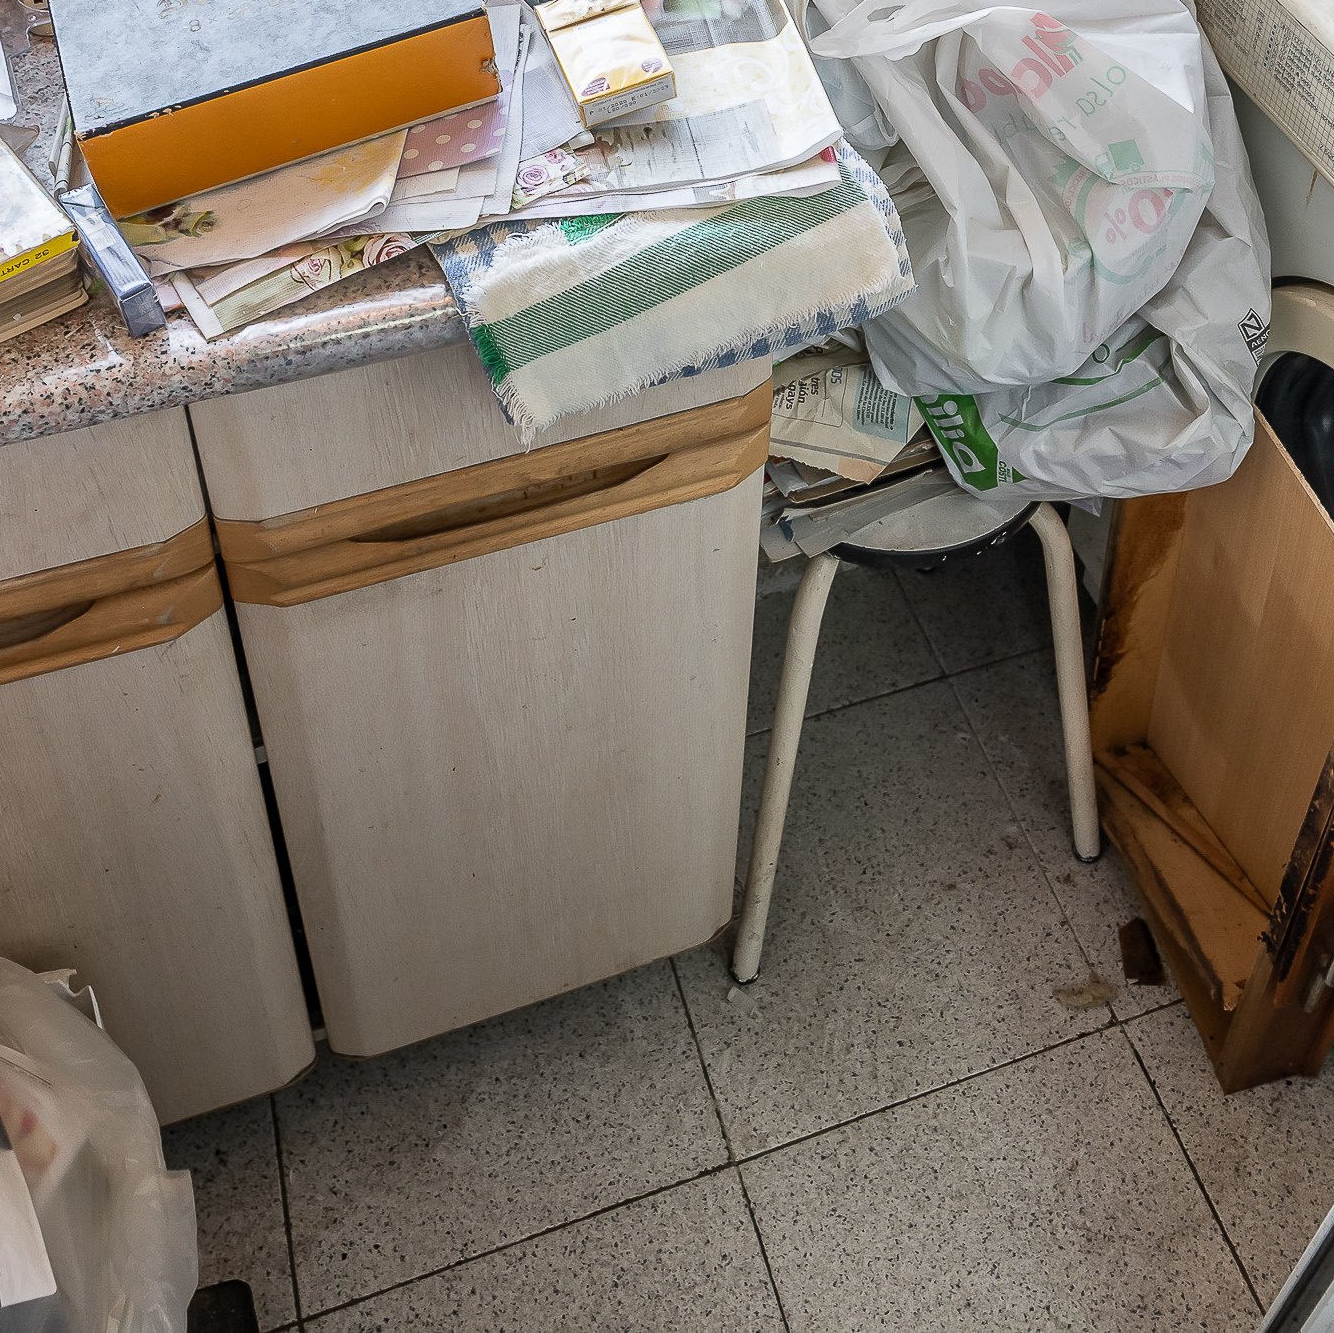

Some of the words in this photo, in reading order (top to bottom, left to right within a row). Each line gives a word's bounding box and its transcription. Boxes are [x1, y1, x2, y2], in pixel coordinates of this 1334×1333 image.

[32, 247, 50, 260] 32
[809, 377, 821, 396] tres
[783, 384, 796, 410] gays
